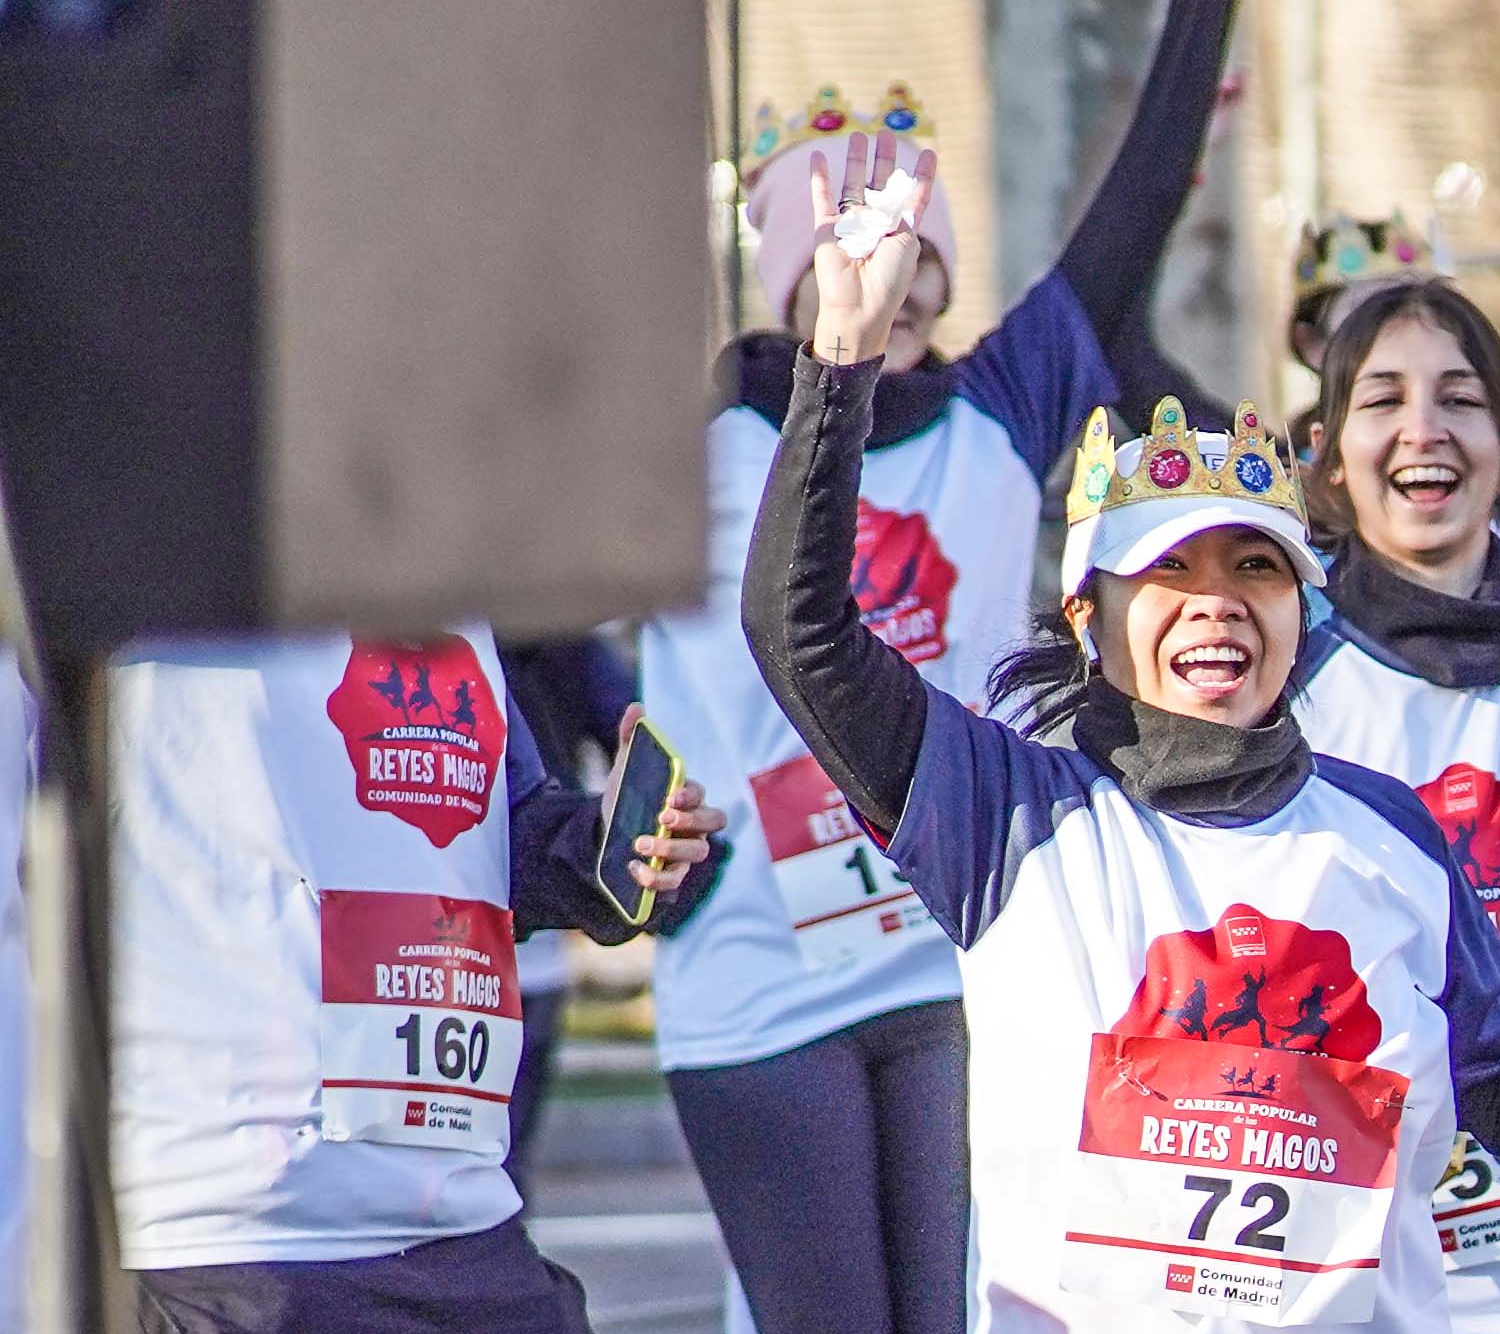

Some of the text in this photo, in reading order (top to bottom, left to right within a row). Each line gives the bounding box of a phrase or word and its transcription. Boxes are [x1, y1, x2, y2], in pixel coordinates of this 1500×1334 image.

[369, 748, 487, 794] REYES MAGOS
[367, 790, 442, 805] COMUNIDAD
[399, 945, 452, 957] CARRERA
[375, 964, 501, 1009] REYES MAGOS
[395, 1013, 490, 1084] 160
[1173, 1098, 1318, 1128] CARRERA POPULAR
[1139, 1115, 1338, 1174] REYES MAGOS
[1184, 1174, 1291, 1252] 72
[1461, 1237, 1480, 1250] de
[1200, 1268, 1283, 1290] Comunidad
[1197, 1284, 1280, 1306] de Madrid
